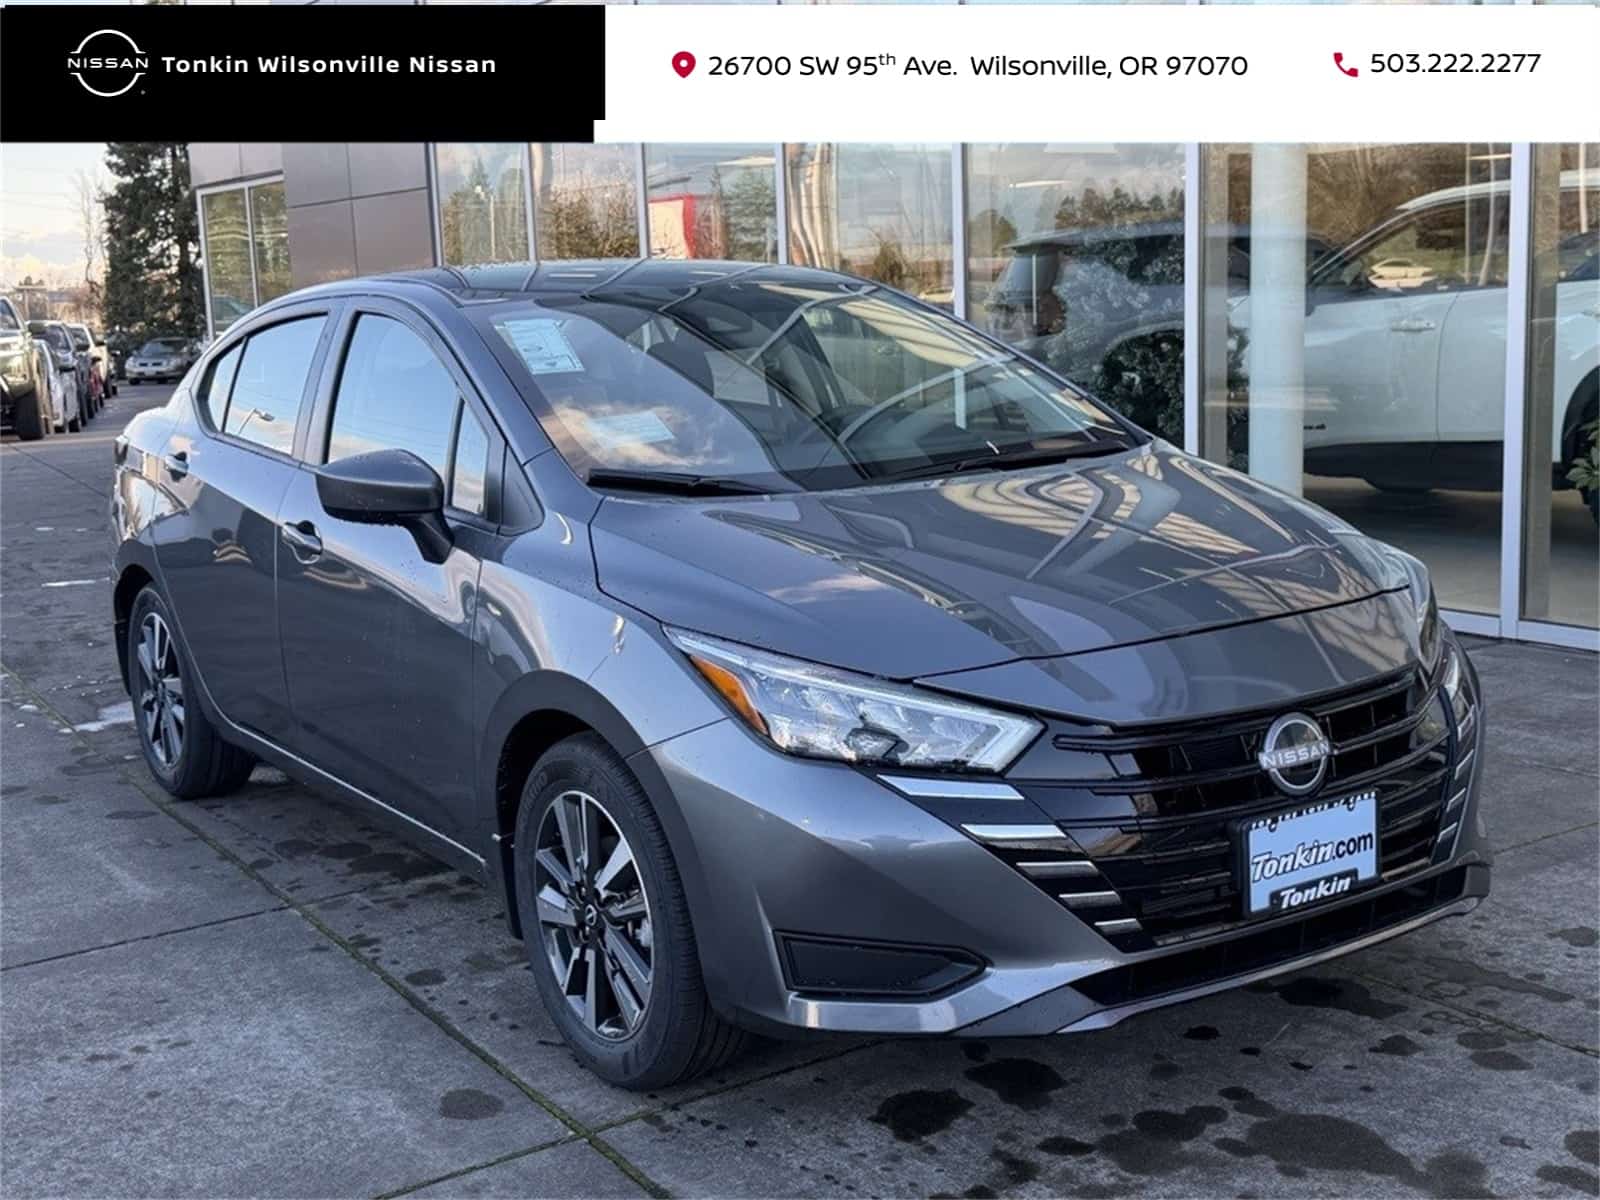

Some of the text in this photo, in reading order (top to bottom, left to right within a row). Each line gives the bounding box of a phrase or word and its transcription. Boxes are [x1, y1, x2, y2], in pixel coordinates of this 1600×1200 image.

[1260, 740, 1329, 768] NISSAN
[1251, 832, 1374, 883] Tonkin.com
[1279, 874, 1351, 909] Tonkin
